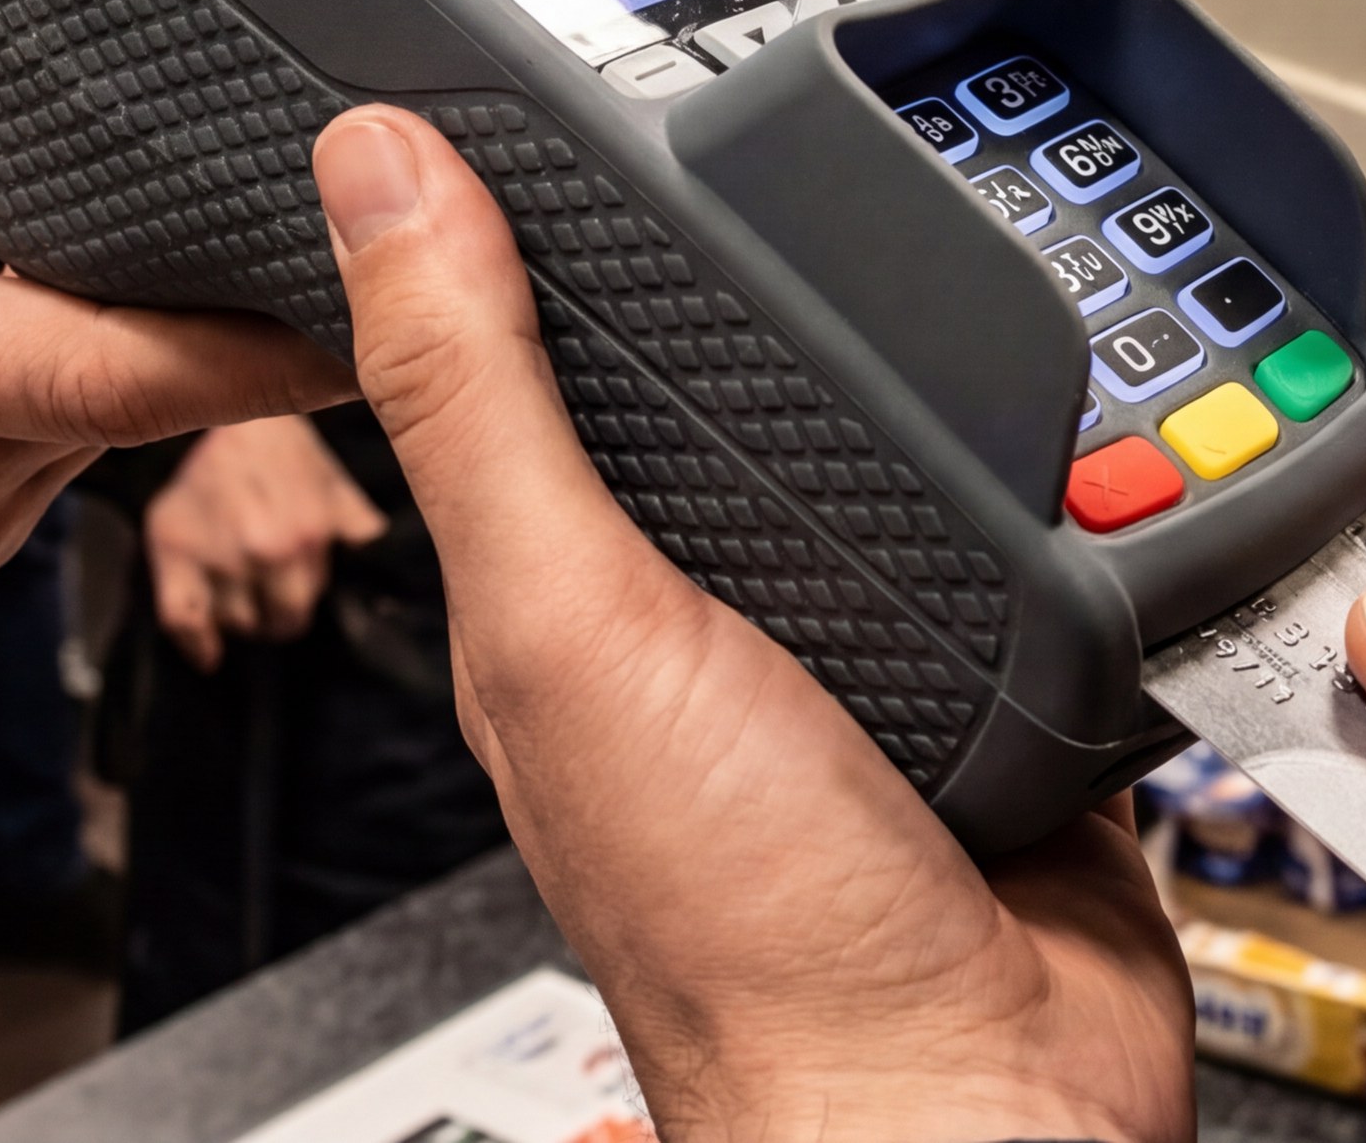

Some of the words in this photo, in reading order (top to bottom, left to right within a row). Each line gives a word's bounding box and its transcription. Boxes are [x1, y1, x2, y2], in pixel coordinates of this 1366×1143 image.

[984, 76, 1025, 108] 3
[1059, 144, 1097, 176] 6
[1132, 212, 1172, 246] 9
